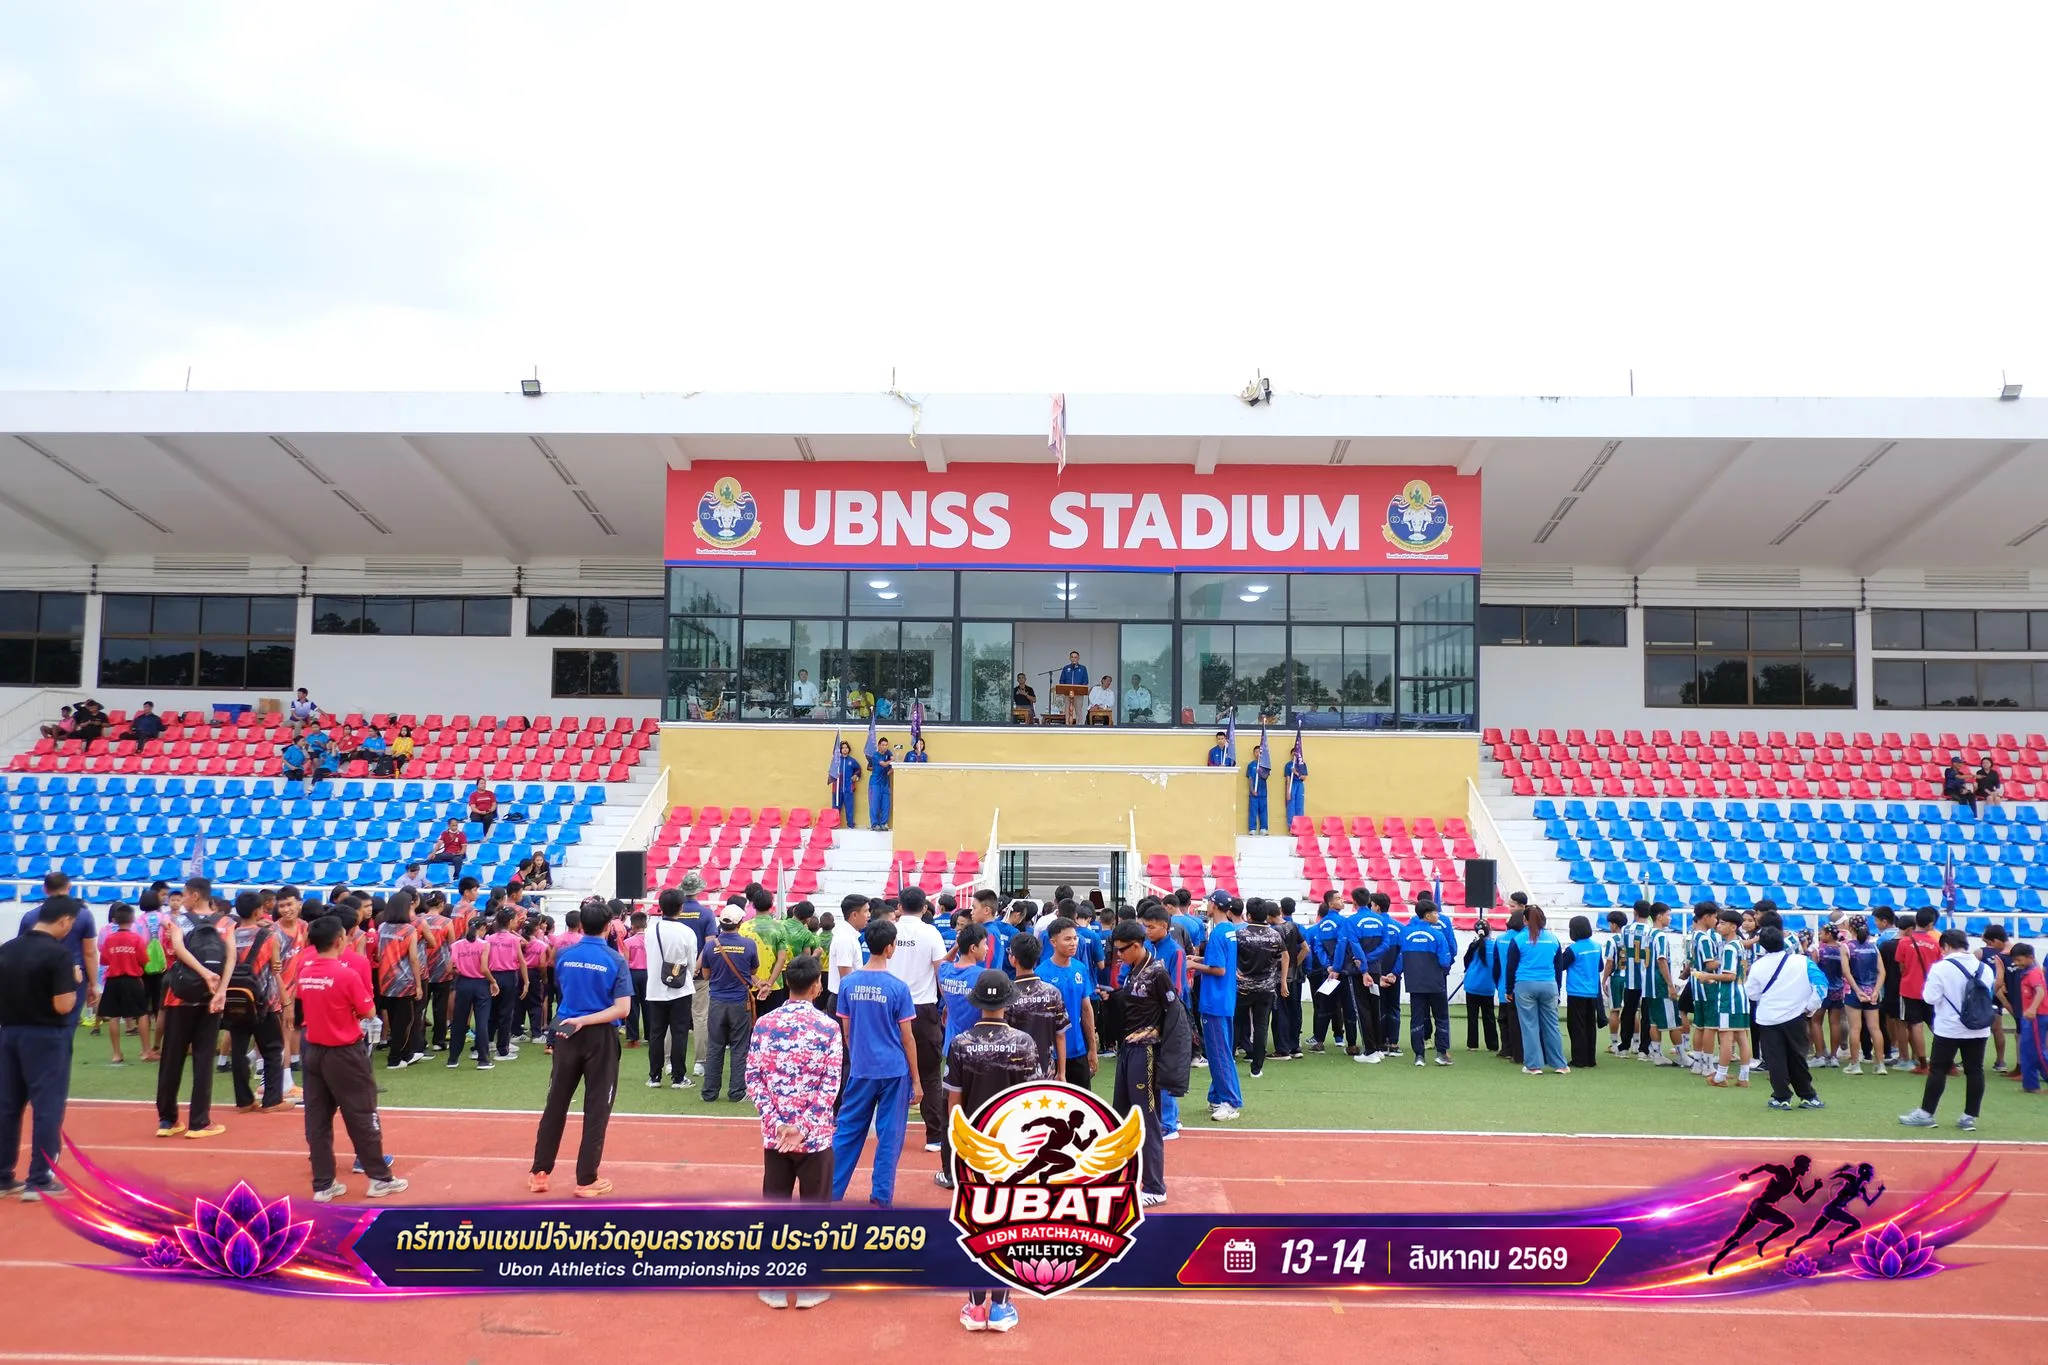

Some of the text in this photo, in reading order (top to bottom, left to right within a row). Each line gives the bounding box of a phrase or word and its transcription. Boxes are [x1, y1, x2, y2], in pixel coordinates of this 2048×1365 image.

[783, 490, 1360, 552] UBNSS STADIUM
[854, 985, 881, 995] UBNSS
[849, 992, 887, 1003] THAILAND
[966, 1043, 1017, 1056] อุบลราชธานี
